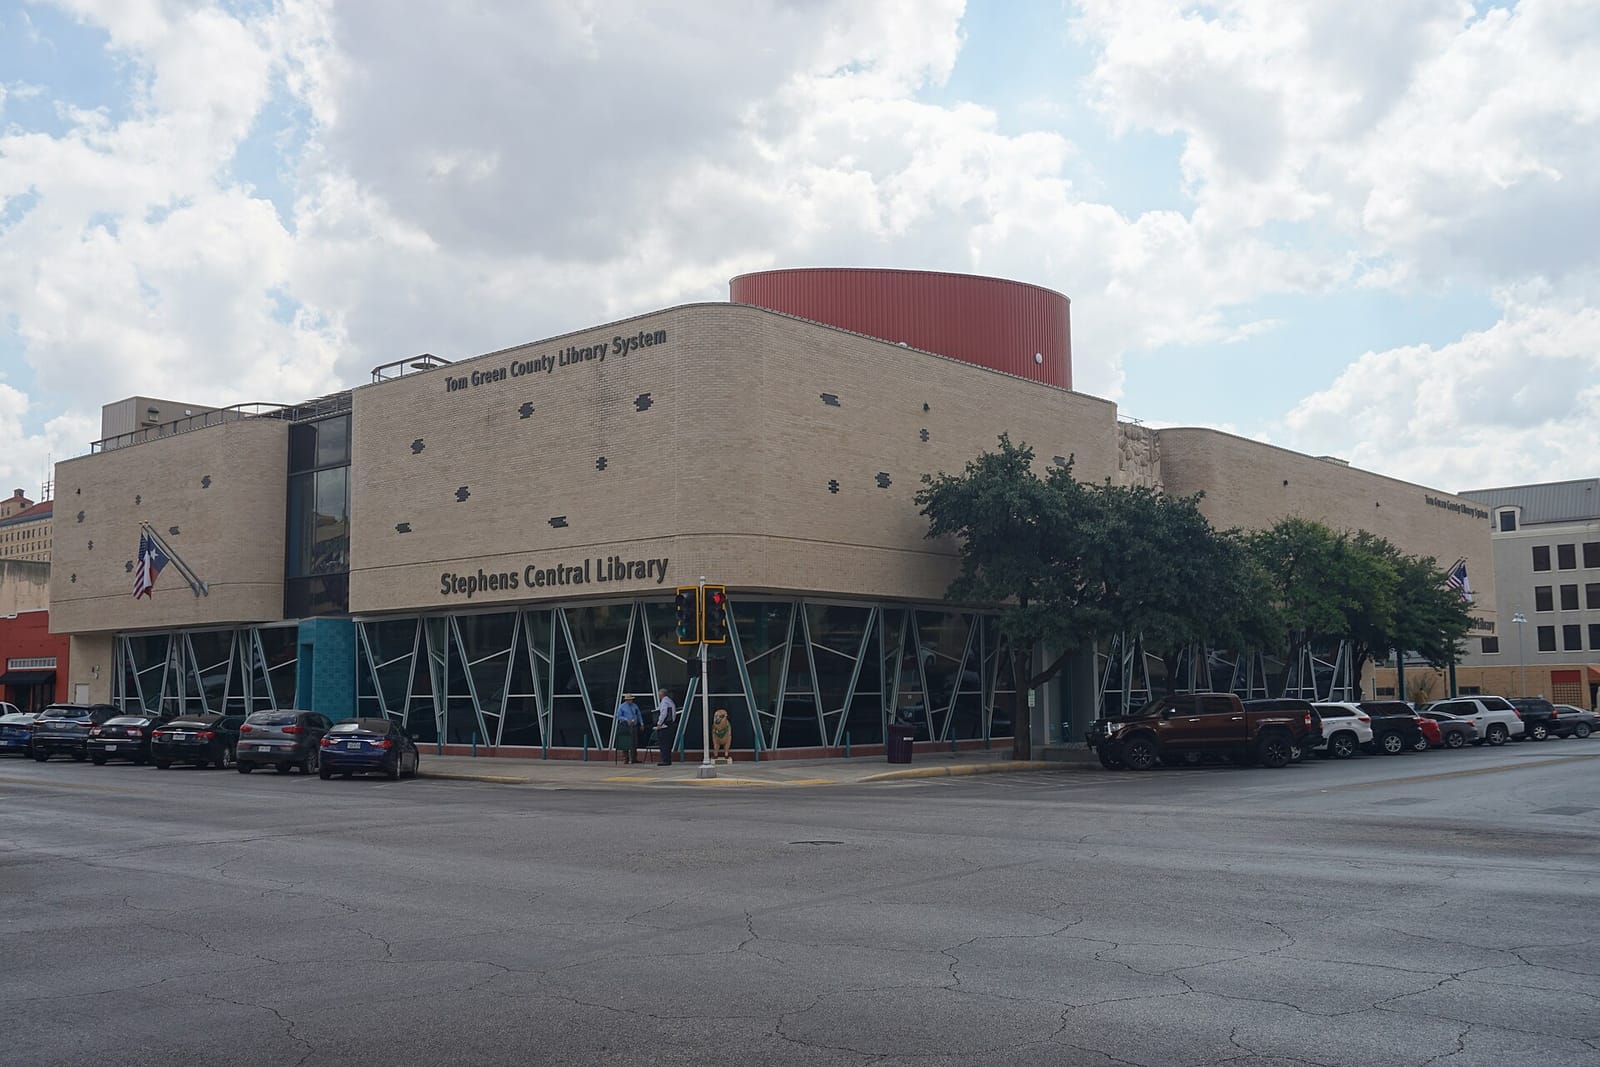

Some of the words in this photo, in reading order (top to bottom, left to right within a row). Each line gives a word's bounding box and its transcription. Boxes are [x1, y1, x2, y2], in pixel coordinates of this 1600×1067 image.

[445, 376, 468, 392] Tom
[471, 366, 506, 387] Green
[510, 354, 555, 377] County
[558, 342, 607, 367] Library
[612, 328, 667, 357] System
[440, 568, 519, 598] Stephens
[524, 558, 591, 588] Central
[596, 555, 669, 584] Library
